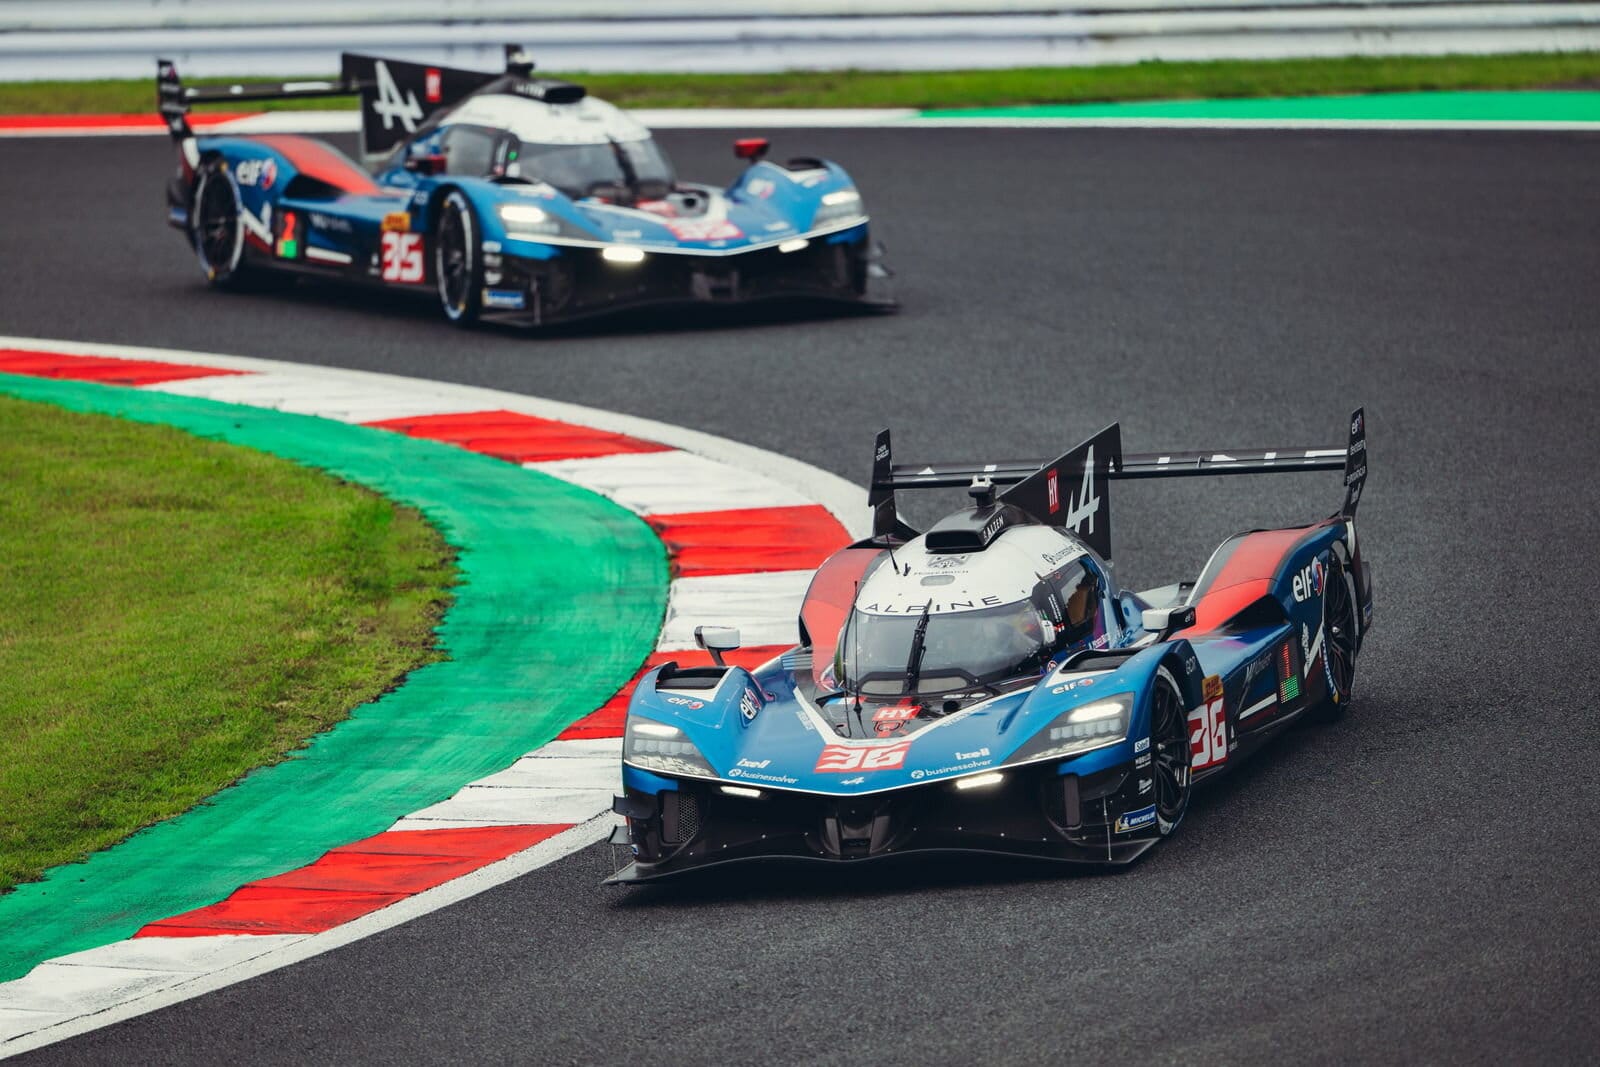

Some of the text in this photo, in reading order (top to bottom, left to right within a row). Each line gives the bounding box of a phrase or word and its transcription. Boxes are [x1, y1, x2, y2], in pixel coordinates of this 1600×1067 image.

[382, 232, 424, 281] 35
[987, 514, 1004, 538] ALTEN
[1293, 566, 1312, 602] elf
[865, 595, 1002, 613] ALPINE
[740, 691, 758, 720] elf
[878, 707, 917, 719] HY
[1188, 698, 1227, 768] 36
[815, 741, 912, 770] 36
[926, 759, 992, 777] businessolver
[740, 770, 799, 784] businessolver
